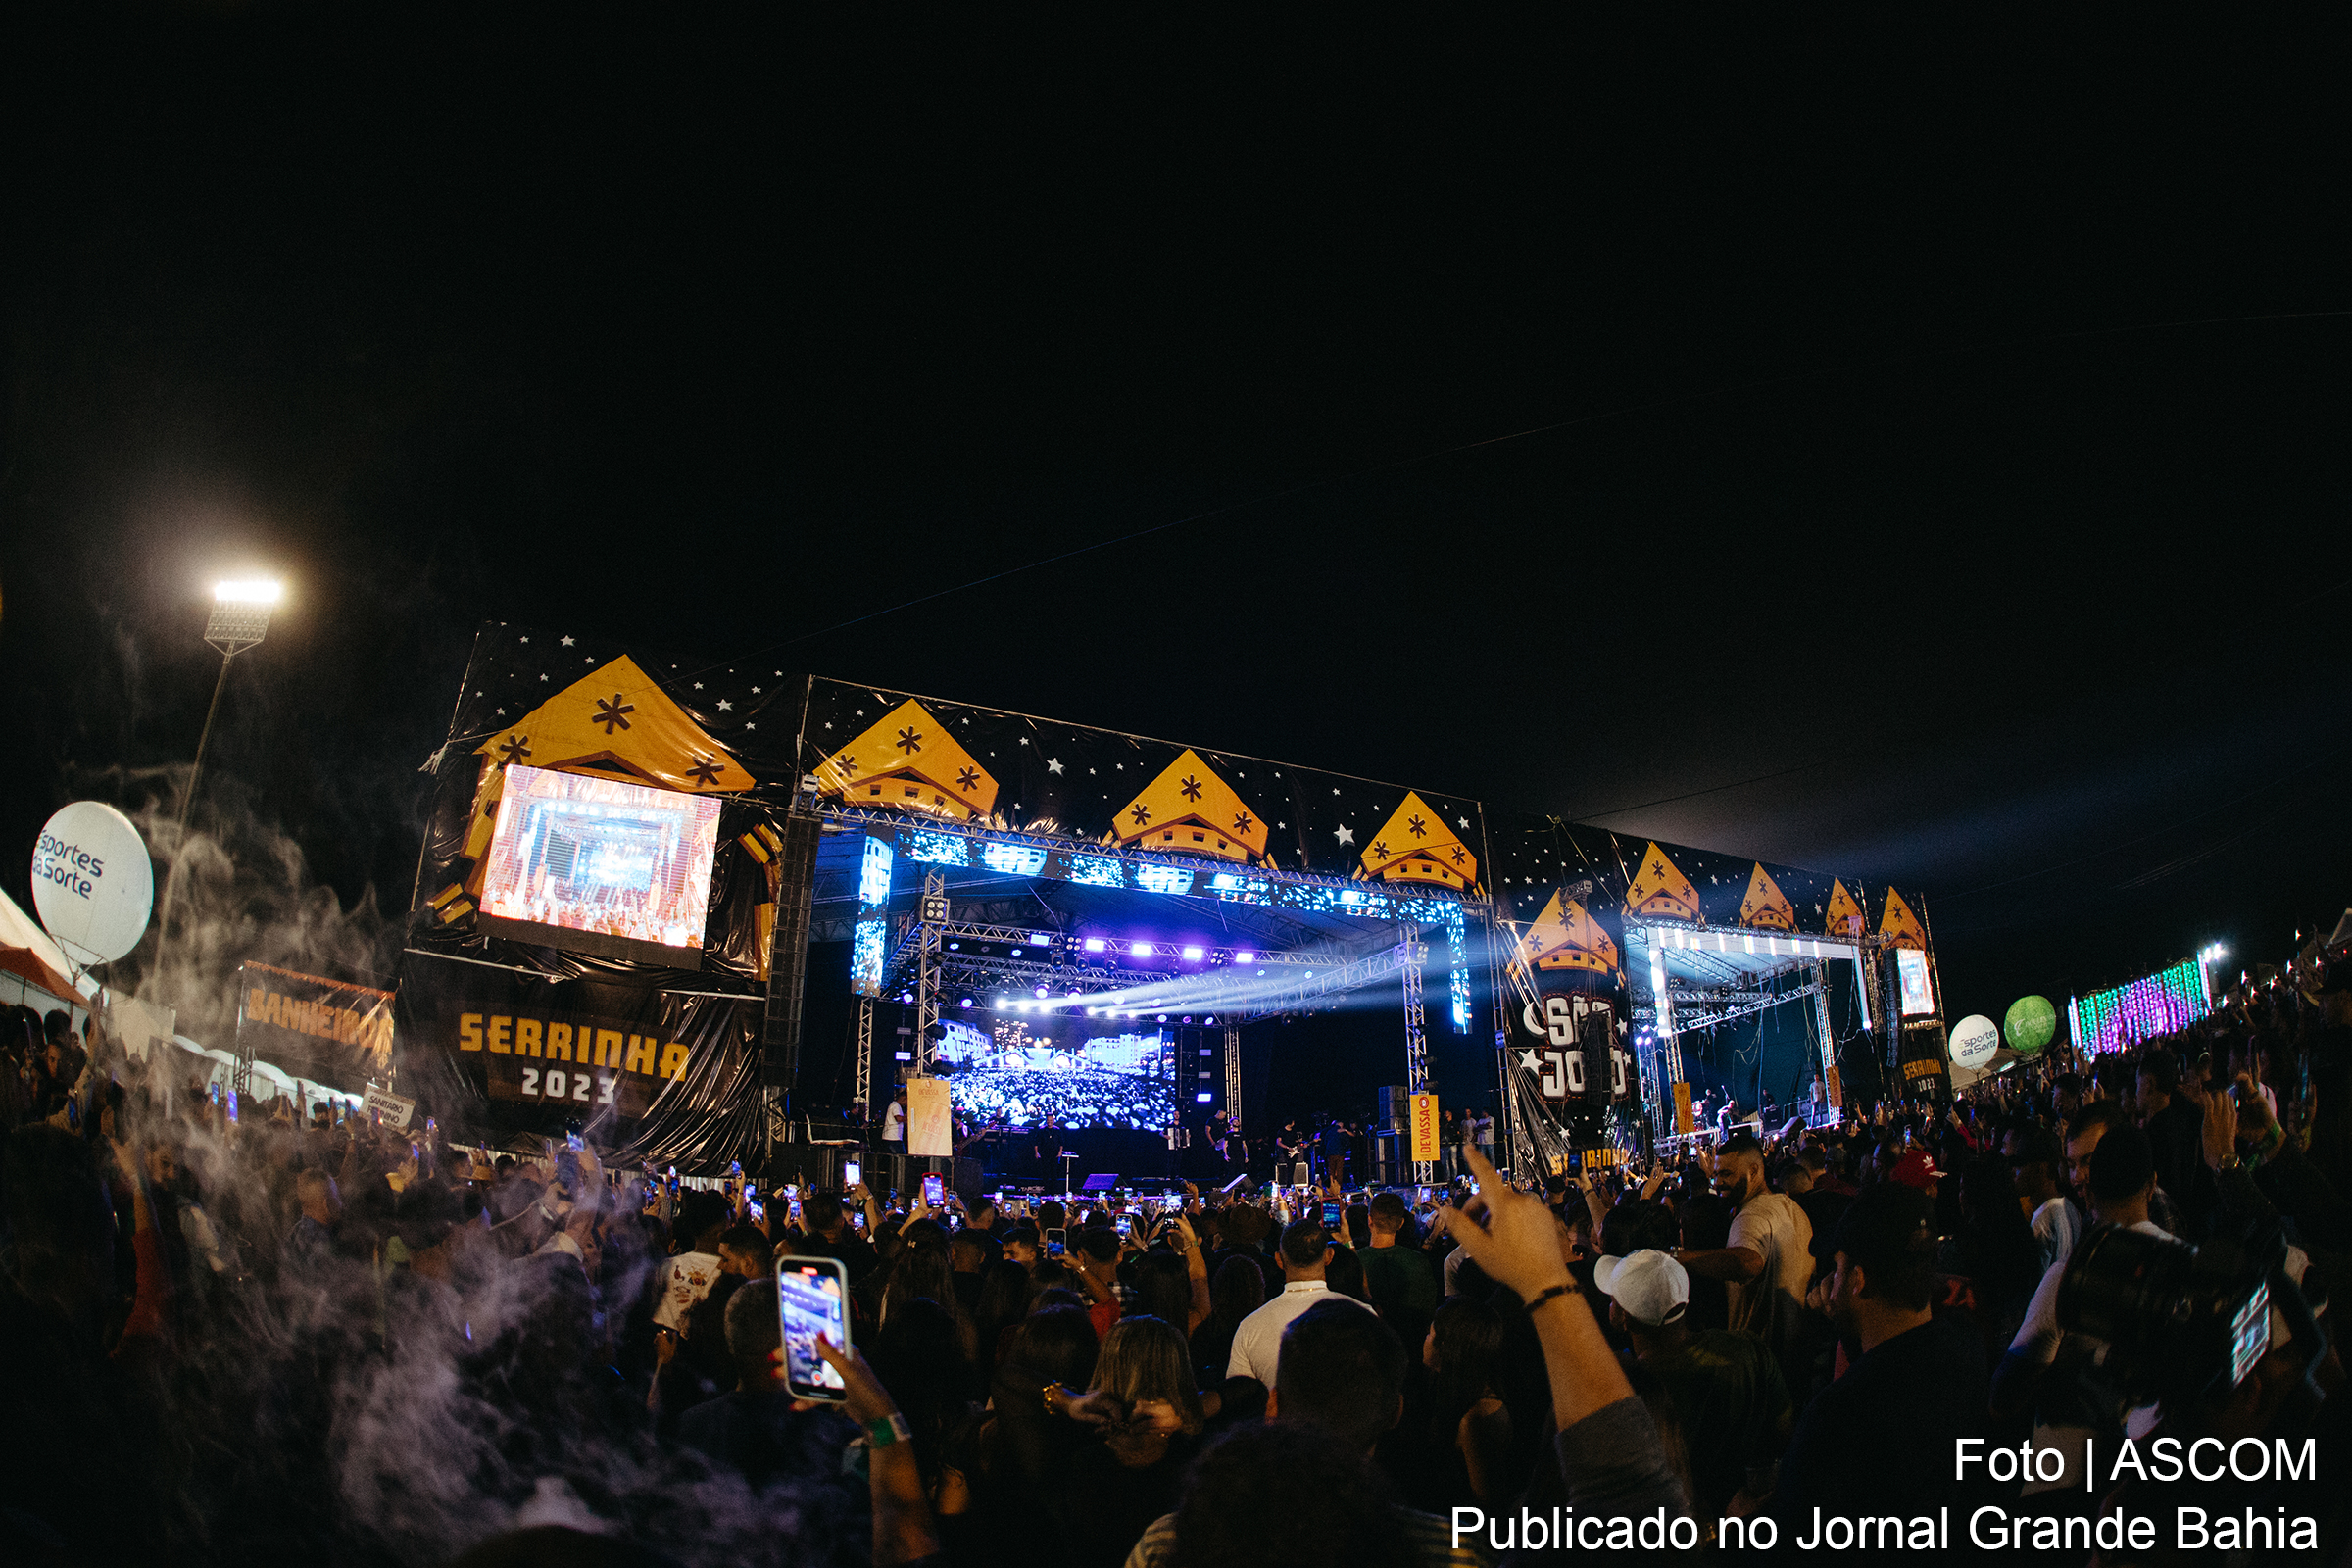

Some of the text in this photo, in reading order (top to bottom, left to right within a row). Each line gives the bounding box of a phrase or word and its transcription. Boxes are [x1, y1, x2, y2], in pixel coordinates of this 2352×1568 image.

[43, 857, 93, 900] Sorte
[460, 1012, 690, 1082] SERRINHA
[1961, 1039, 1996, 1057] da Sorte
[521, 1067, 615, 1104] 2023
[1543, 1050, 1627, 1097] JOO
[1419, 1109, 1432, 1153] DEVASSA
